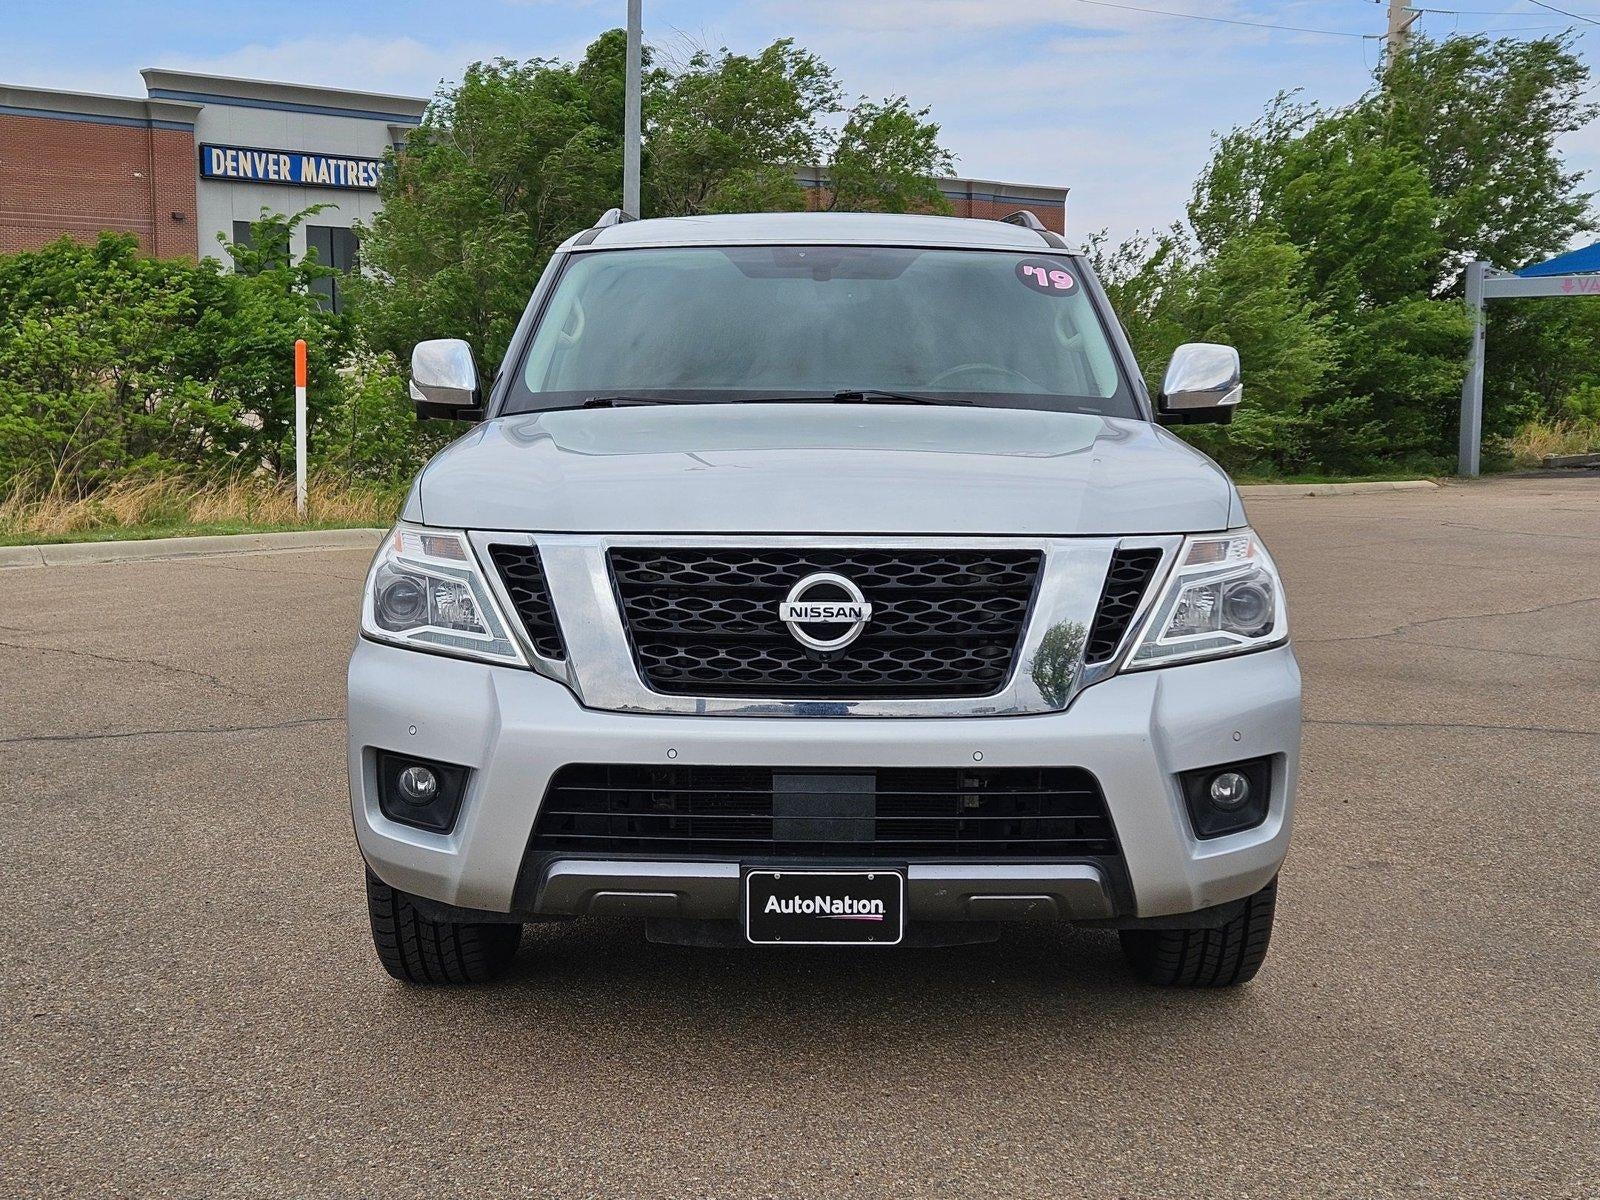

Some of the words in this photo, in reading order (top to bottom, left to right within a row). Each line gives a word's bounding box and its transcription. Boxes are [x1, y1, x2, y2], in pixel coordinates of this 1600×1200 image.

[211, 148, 291, 180] DENVER
[1023, 265, 1074, 290] '19
[789, 606, 862, 618] NISSAN
[764, 895, 884, 914] AutoNation
